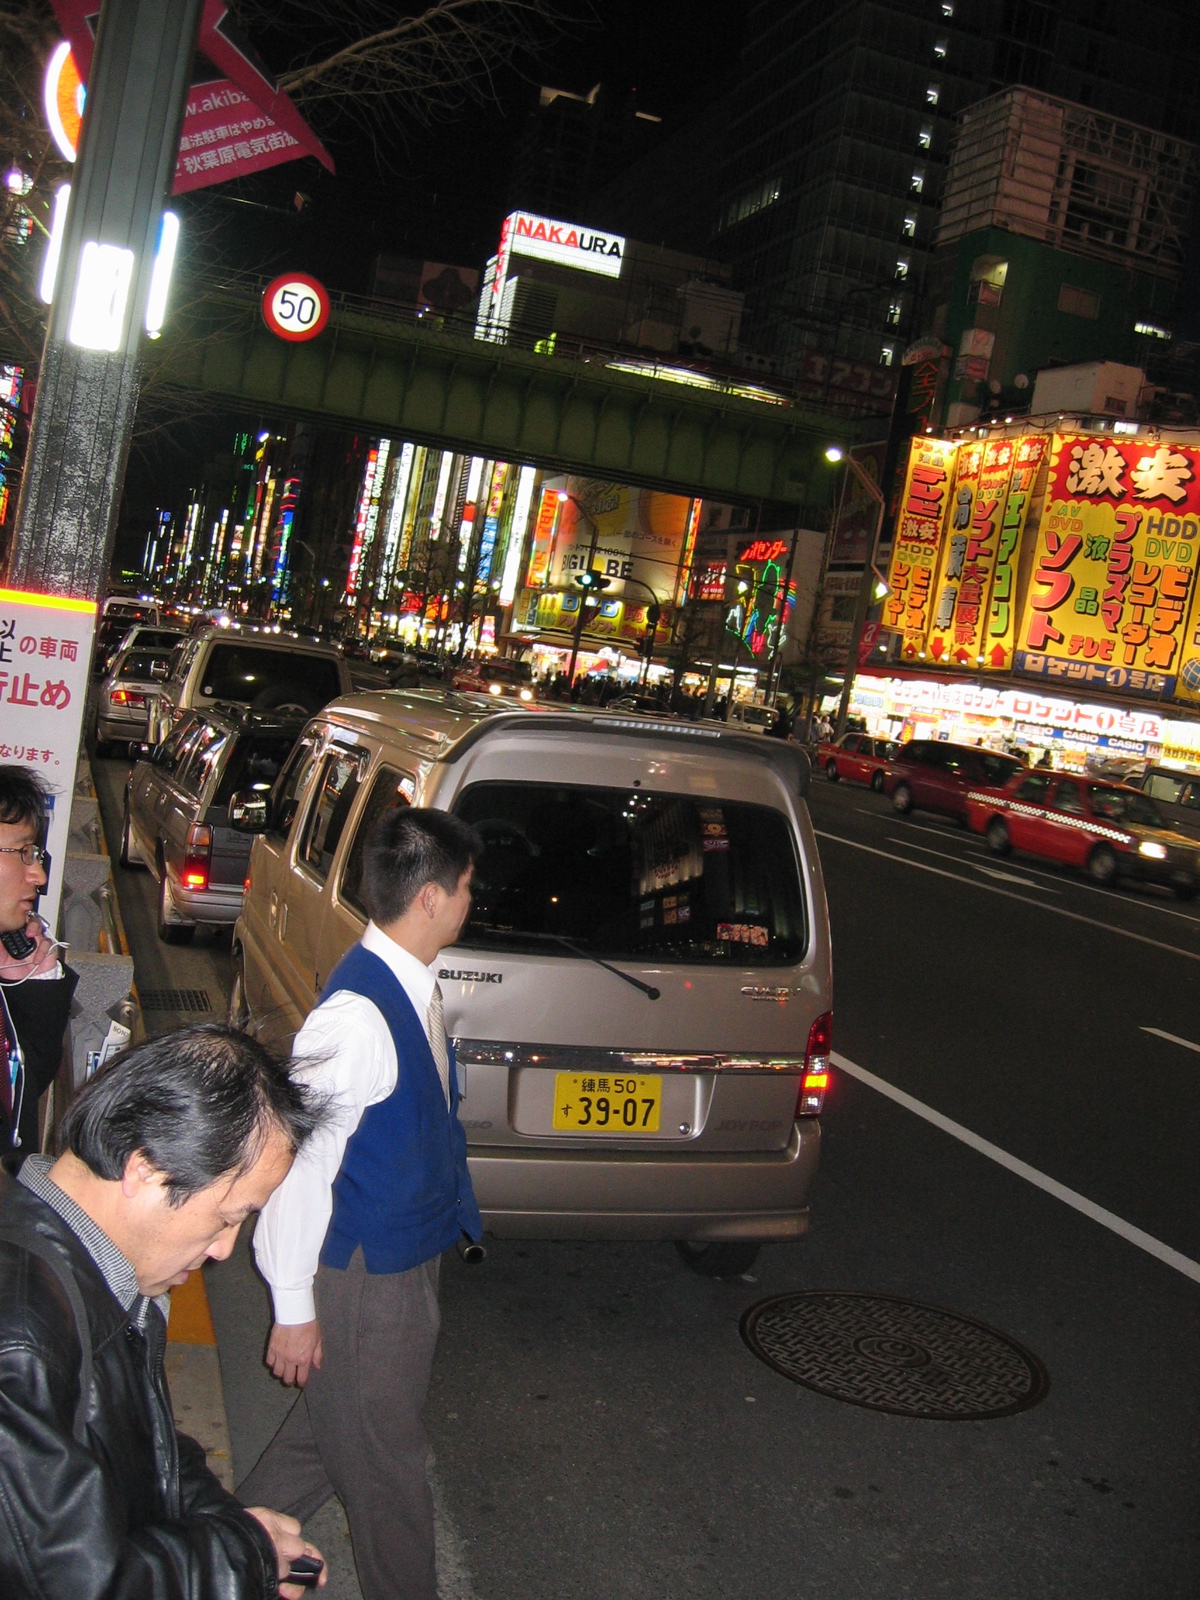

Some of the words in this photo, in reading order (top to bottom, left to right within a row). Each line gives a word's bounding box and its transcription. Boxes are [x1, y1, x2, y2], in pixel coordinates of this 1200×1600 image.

[516, 217, 622, 259] NAKAURA
[279, 290, 315, 325] 50
[986, 446, 1010, 467] 激安
[1018, 443, 1041, 462] 激安
[1065, 441, 1191, 501] 激安
[907, 464, 946, 518] テレビ
[1057, 504, 1080, 517] AV
[902, 518, 936, 541] 激安
[1048, 516, 1083, 532] DVD
[1146, 515, 1197, 540] HDD
[896, 551, 932, 566] DVD
[897, 543, 935, 557] HDD
[1144, 537, 1192, 562] DVD
[989, 493, 1025, 638] エアコン
[1074, 533, 1110, 616] 液晶
[1101, 511, 1142, 633] プラズマ
[887, 561, 911, 625] レコーダー
[906, 565, 931, 630] ビデオ
[1026, 531, 1083, 650] ソフト
[1122, 561, 1160, 664] レコーダー
[1143, 564, 1192, 667] ビデオ
[20, 635, 79, 661] の車両
[1067, 635, 1116, 660] テレビ
[1063, 730, 1099, 744] CASIO
[1108, 738, 1144, 752] CASIO
[438, 968, 502, 984] SUZUKI
[581, 1078, 610, 1093] 練馬
[614, 1079, 637, 1094] 50
[561, 1104, 573, 1118] す
[577, 1097, 655, 1127] 39-07
